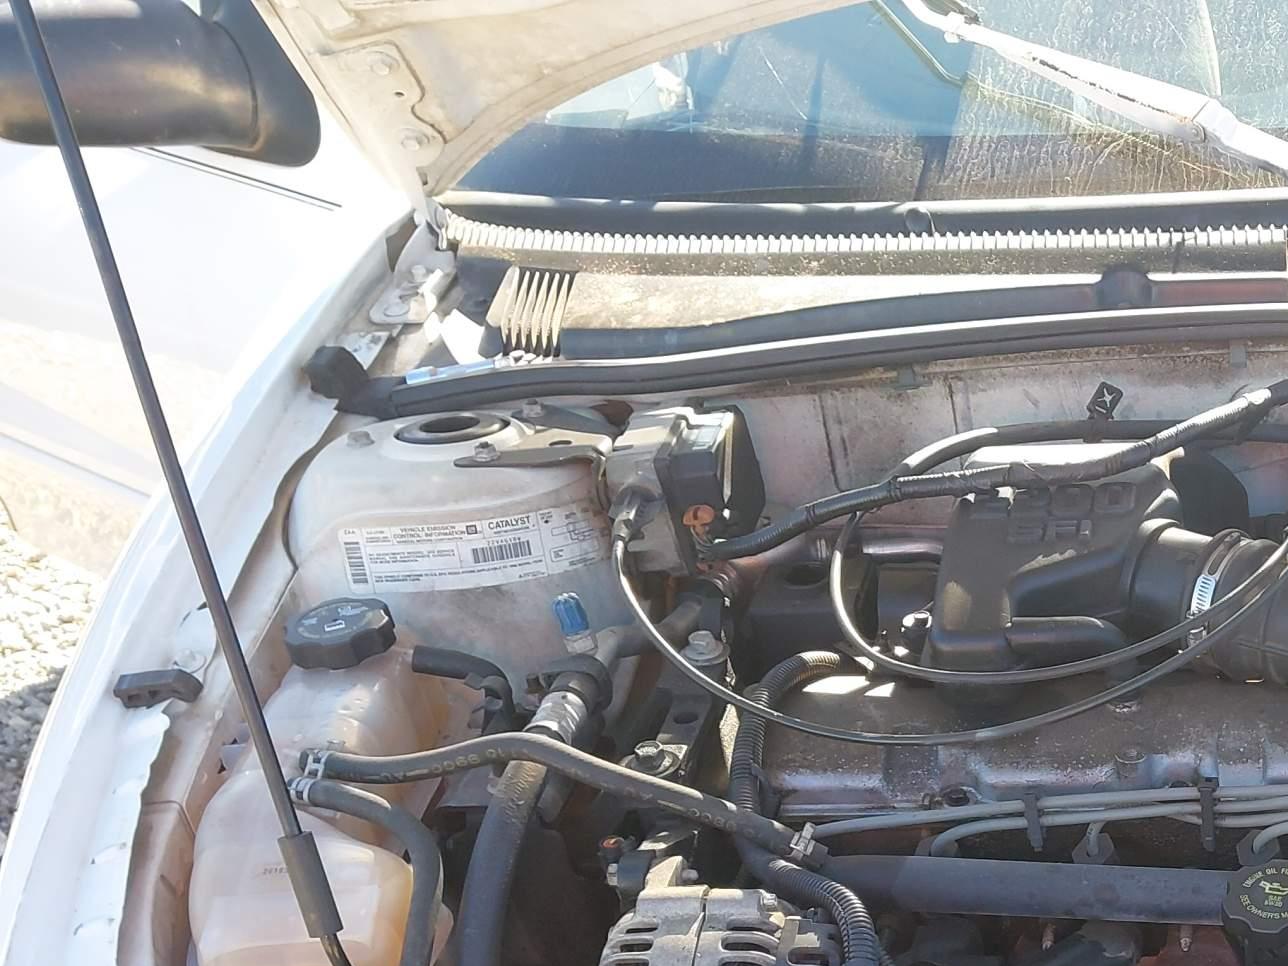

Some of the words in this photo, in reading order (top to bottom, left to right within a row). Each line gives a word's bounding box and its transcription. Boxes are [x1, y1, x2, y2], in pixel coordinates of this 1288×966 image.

[488, 516, 530, 530] CATALYST
[1266, 867, 1278, 875] OIL
[1240, 895, 1251, 907] SEE
